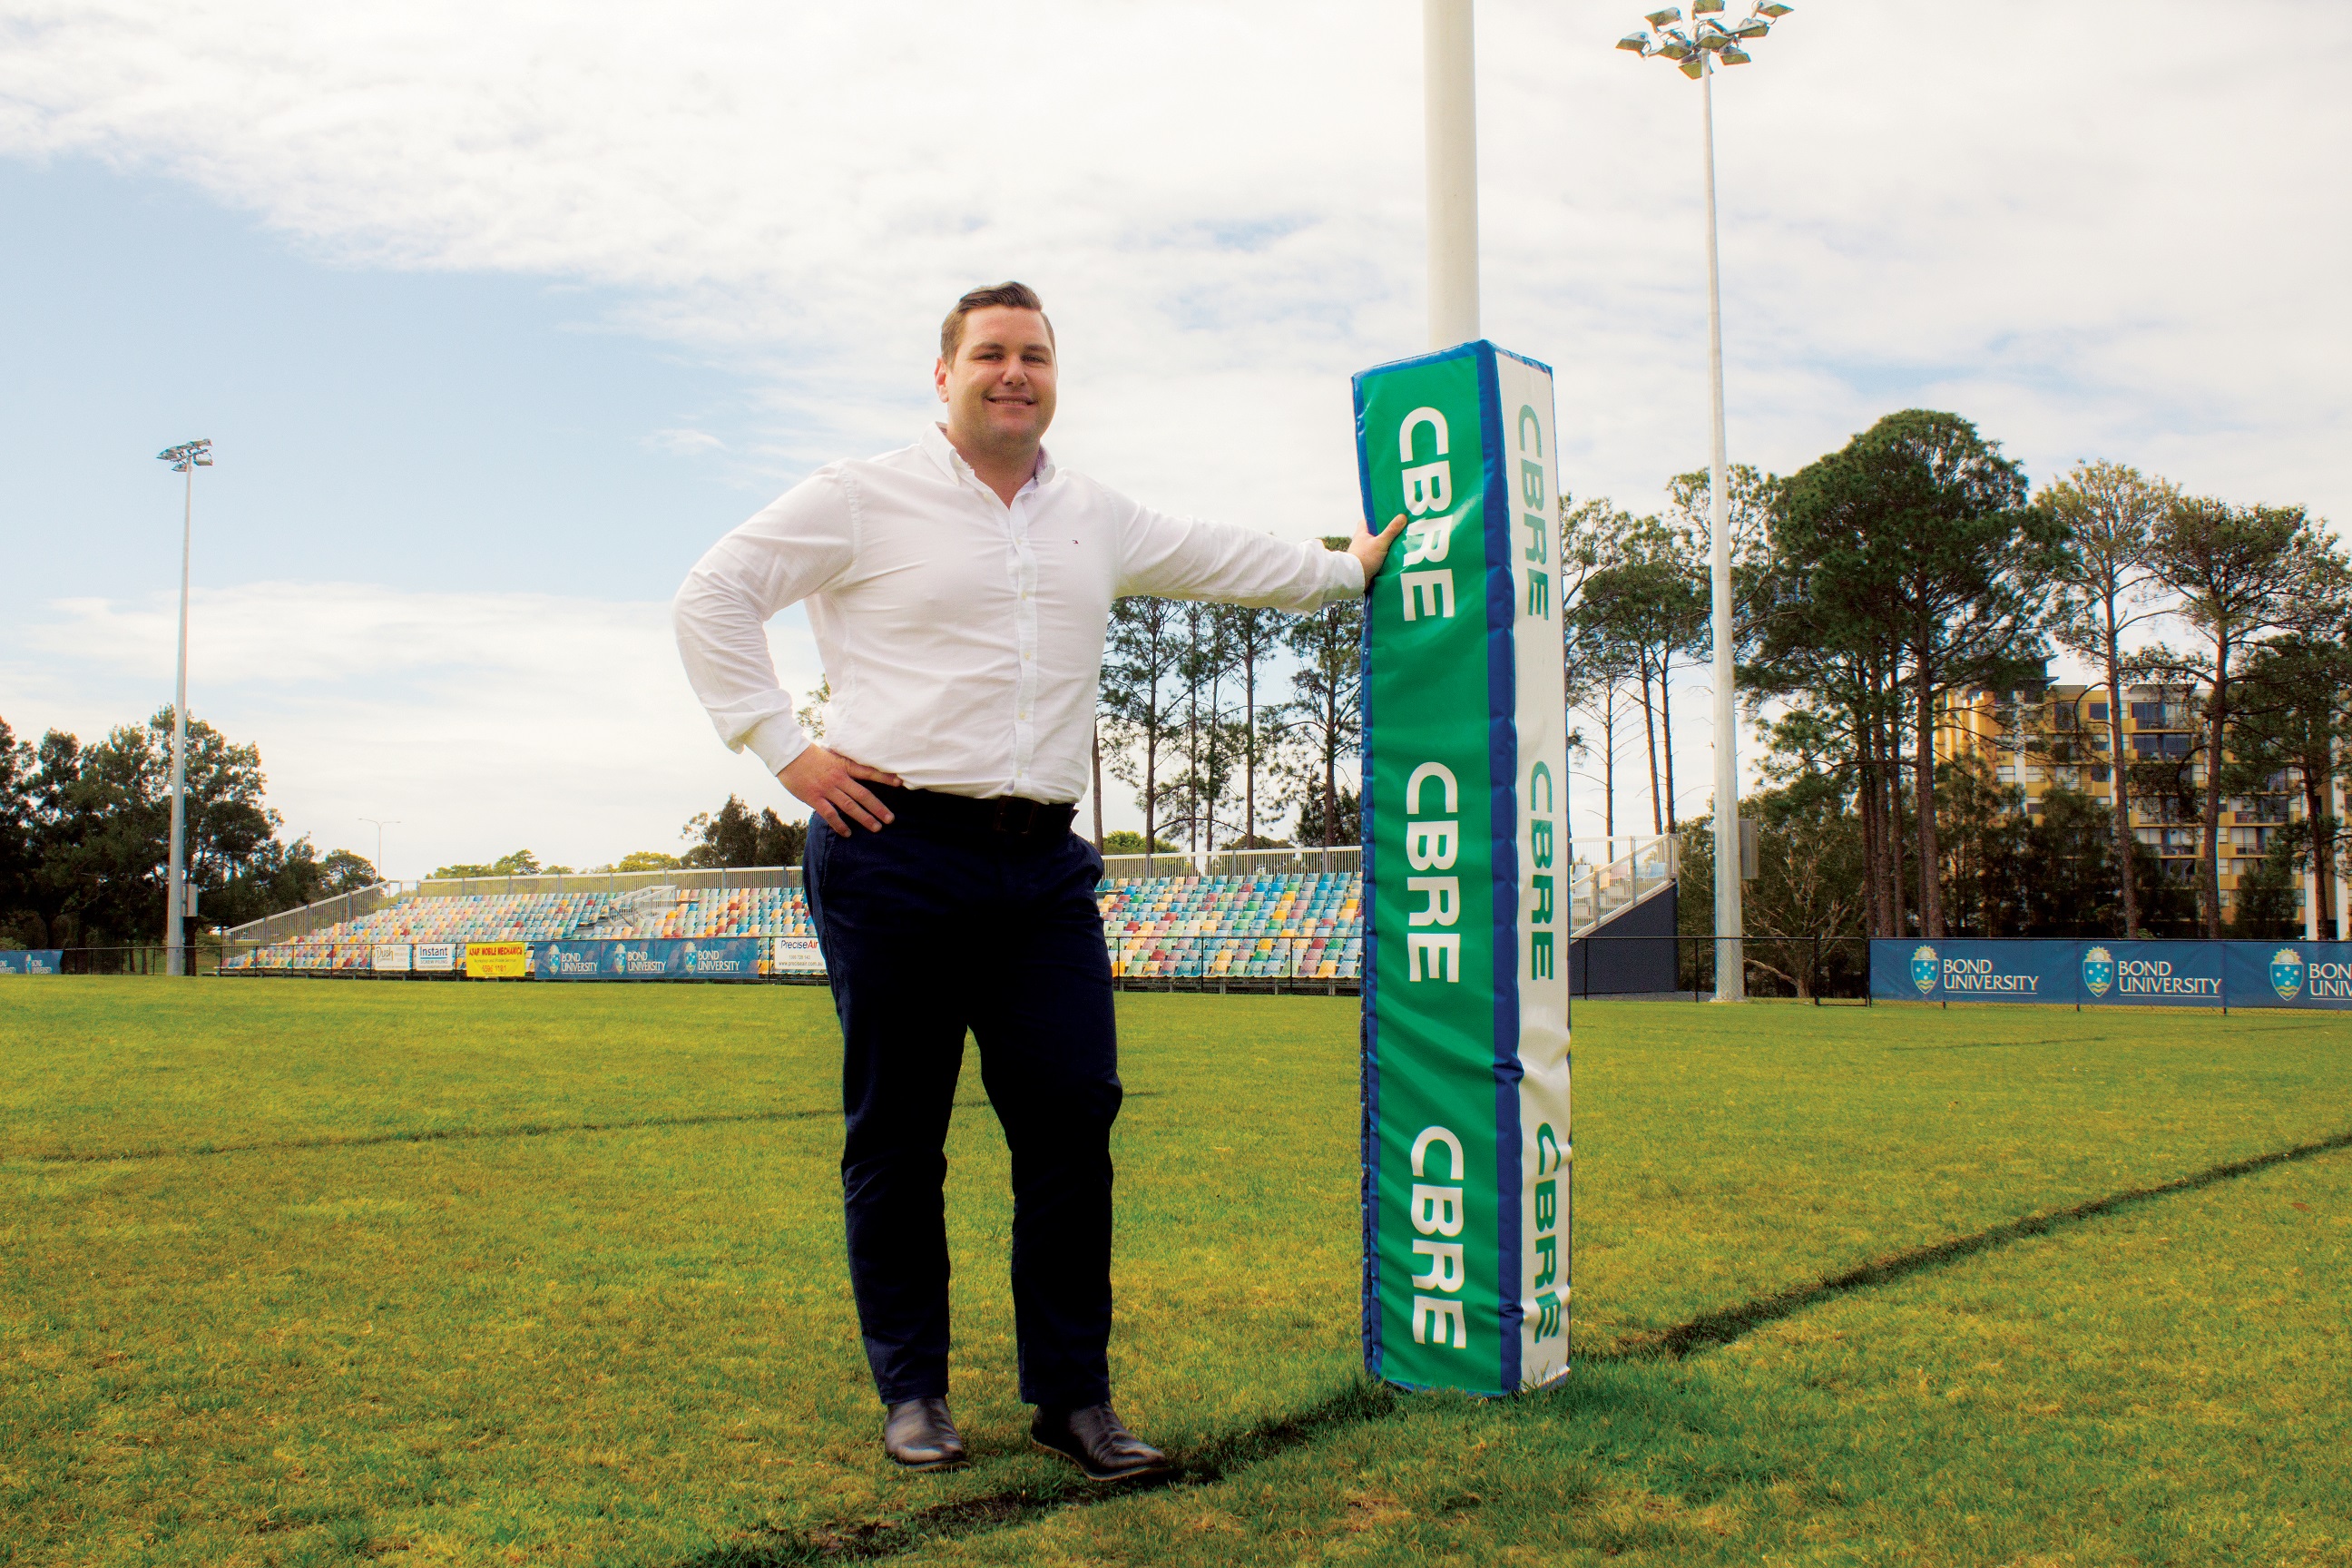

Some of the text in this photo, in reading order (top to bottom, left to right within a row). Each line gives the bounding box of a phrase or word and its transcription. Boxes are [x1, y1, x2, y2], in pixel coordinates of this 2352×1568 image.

[1398, 406, 1455, 622] CBRE
[1517, 404, 1550, 622] CBRE
[1406, 760, 1461, 983] CBRE
[1530, 760, 1554, 981] CBRE
[420, 946, 448, 956] Instant
[780, 939, 818, 949] PreciseAir
[562, 952, 581, 962] BOND
[627, 951, 648, 961] BOND
[698, 950, 720, 960] BOND
[562, 962, 598, 972] UNIVERSITY
[627, 961, 667, 972] UNIVERSITY
[698, 960, 740, 971] UNIVERSITY
[1943, 958, 1993, 974] BOND
[2118, 960, 2172, 976] BOND
[2308, 963, 2352, 979] BON
[1943, 974, 2039, 990] UNIVERSITY
[2119, 976, 2222, 994] UNIVERSITY
[1410, 1125, 1466, 1348] CBRE
[1534, 1122, 1562, 1345] CBRE
